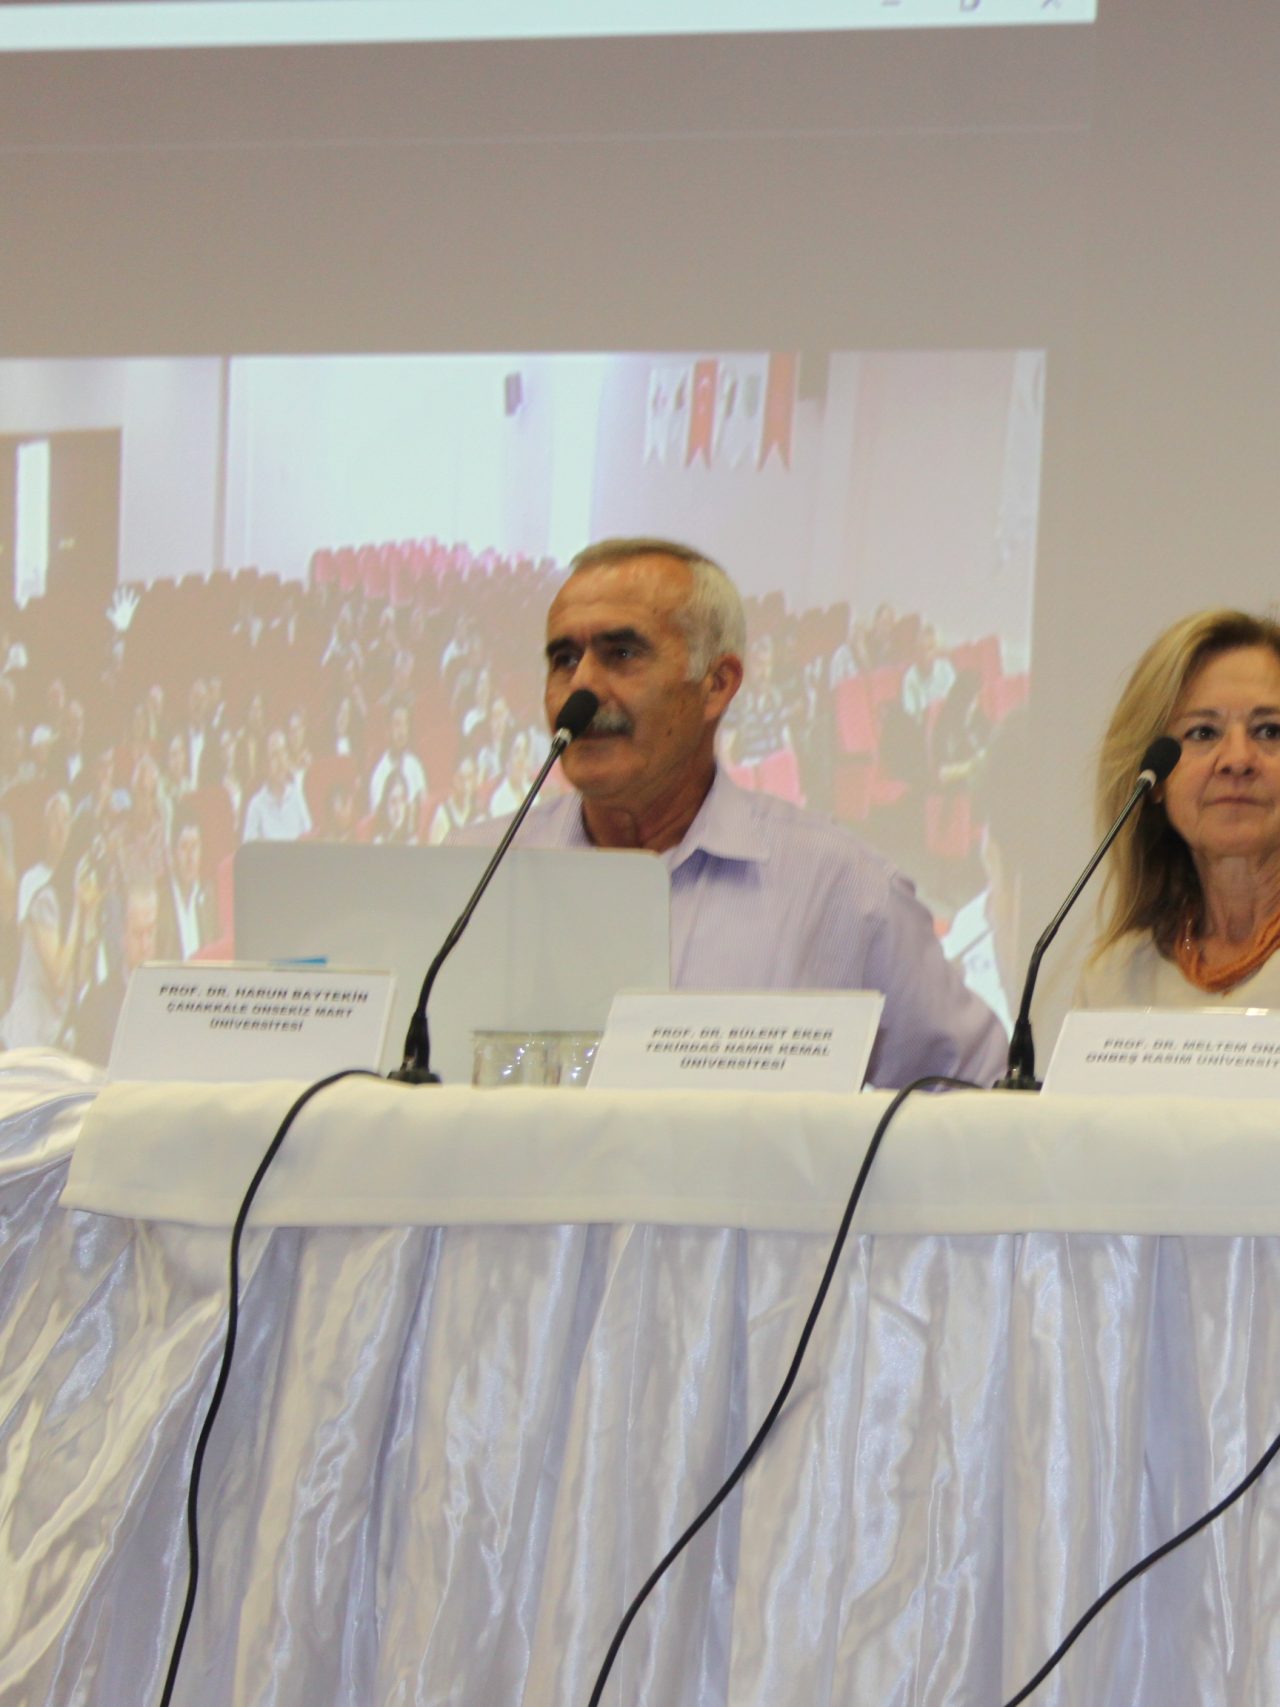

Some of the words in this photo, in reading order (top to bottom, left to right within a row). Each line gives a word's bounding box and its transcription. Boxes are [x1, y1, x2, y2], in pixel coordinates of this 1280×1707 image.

[160, 985, 201, 997] PROF.
[207, 986, 230, 998] DR.
[235, 987, 287, 1000] HARUN
[292, 988, 369, 1003] BAYTEKİN
[315, 1007, 353, 1018] MART
[652, 1026, 695, 1038] PROF.
[700, 1027, 722, 1038] DR.
[1103, 1038, 1148, 1049] PROF.
[1152, 1039, 1176, 1050] DR.
